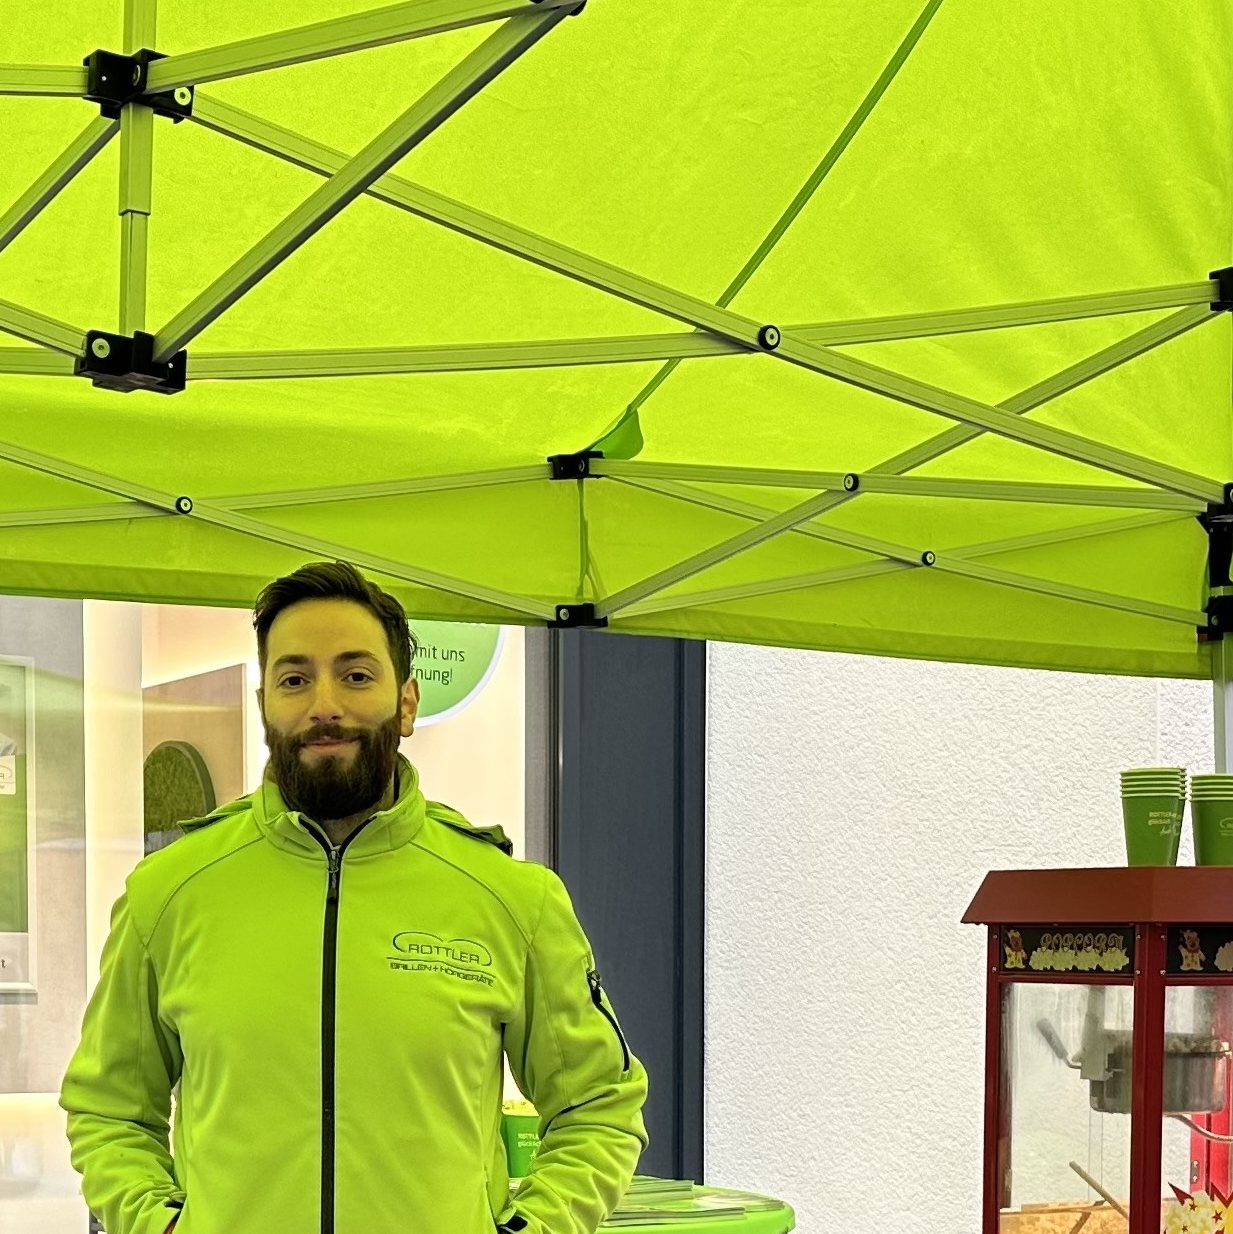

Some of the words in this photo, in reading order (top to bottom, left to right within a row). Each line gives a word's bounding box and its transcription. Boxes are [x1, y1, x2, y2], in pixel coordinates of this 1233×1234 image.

[416, 643, 437, 660] mit
[441, 648, 466, 662] uns
[411, 664, 453, 686] fnung!
[408, 943, 480, 965] ROTTLER
